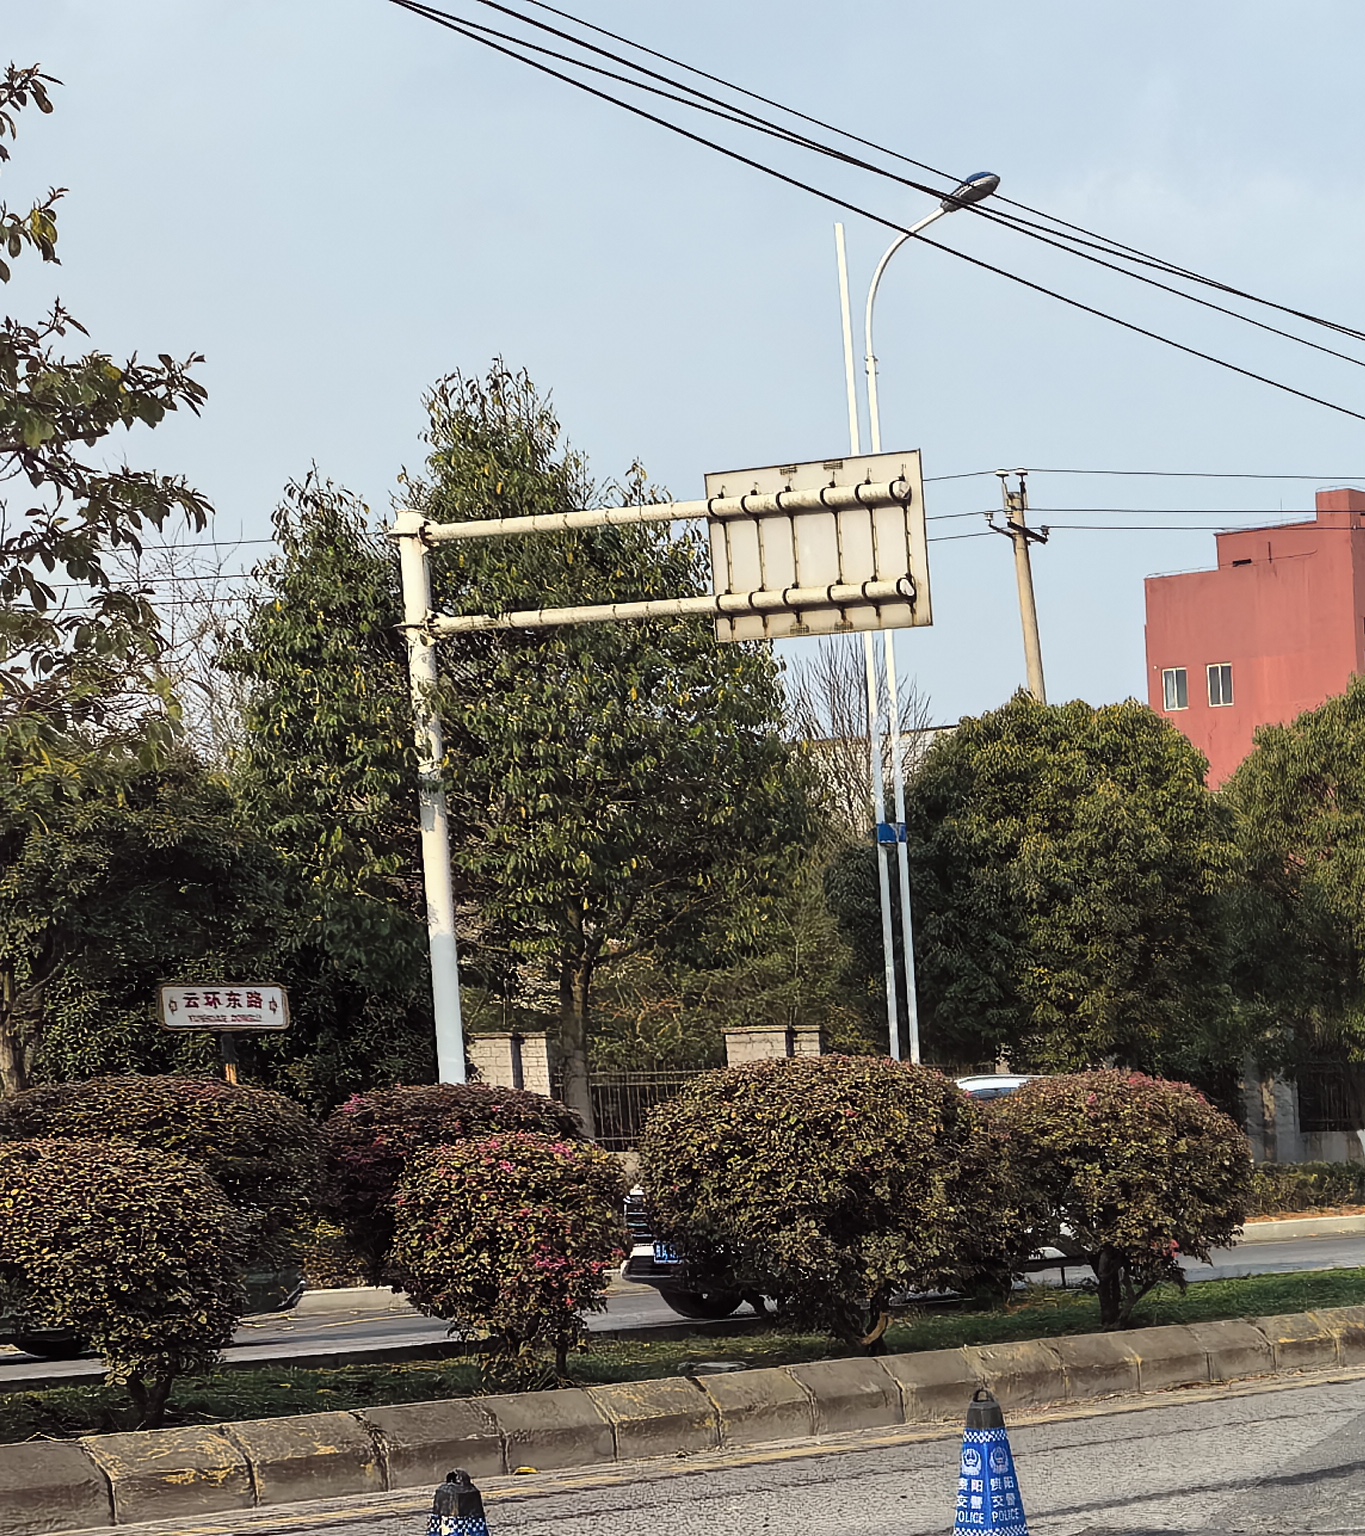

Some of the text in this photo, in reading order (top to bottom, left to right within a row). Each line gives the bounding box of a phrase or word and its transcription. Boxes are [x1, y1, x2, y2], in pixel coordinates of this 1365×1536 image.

[182, 990, 263, 1009] 云环东路
[956, 1509, 985, 1524] OLICE
